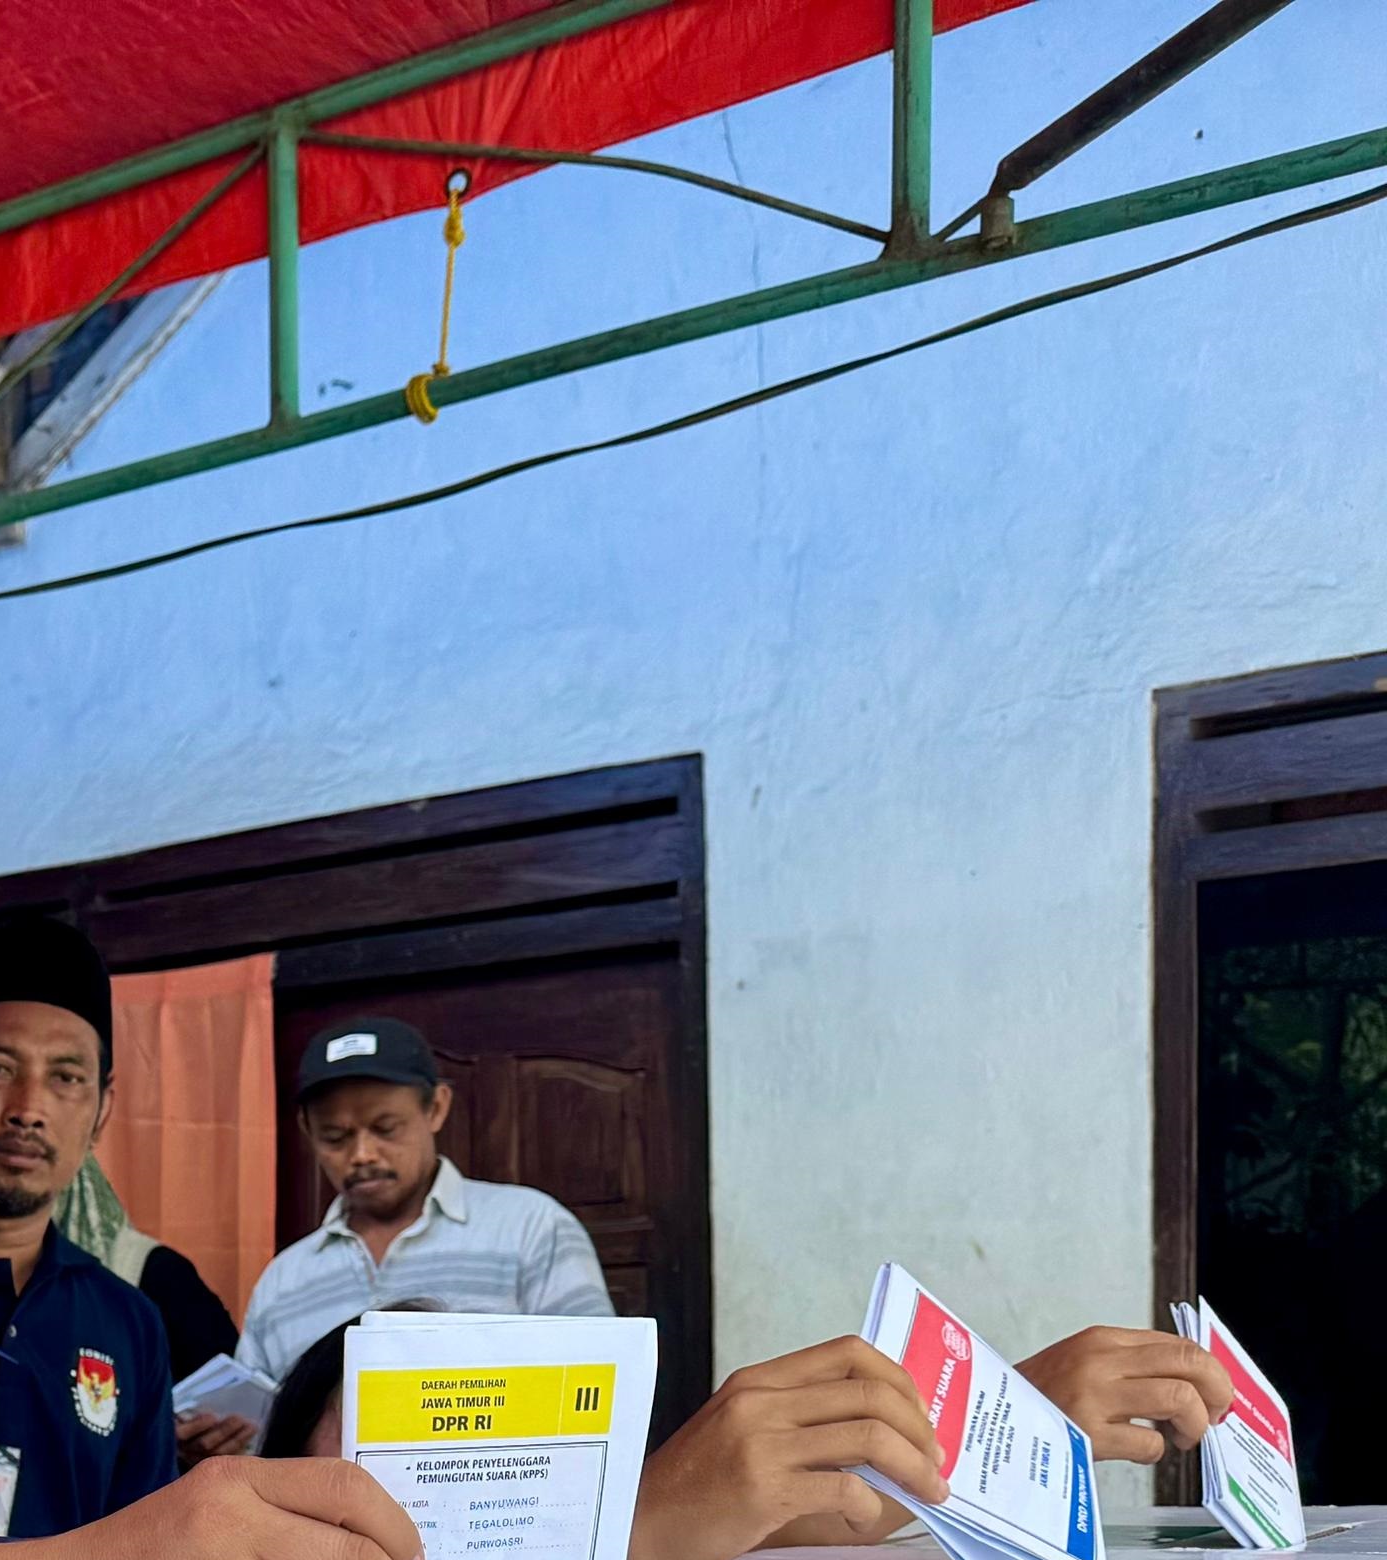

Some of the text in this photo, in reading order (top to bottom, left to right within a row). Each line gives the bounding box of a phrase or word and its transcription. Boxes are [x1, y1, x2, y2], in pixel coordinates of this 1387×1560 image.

[421, 1379, 506, 1390] DAERAH PEMILIHAN
[936, 1358, 957, 1399] SUARA
[421, 1396, 505, 1409] JAWA TIMUR III
[575, 1387, 600, 1411] III
[432, 1415, 491, 1432] DPR RI
[416, 1456, 551, 1471] KELOMPOK PENYELENGGARA
[416, 1469, 548, 1484] PEMUNGUTAN SUARA (KPPS)
[412, 1500, 428, 1508] KOTA
[469, 1497, 540, 1510] BANYUWANGI
[467, 1537, 524, 1550] PURWOASRI
